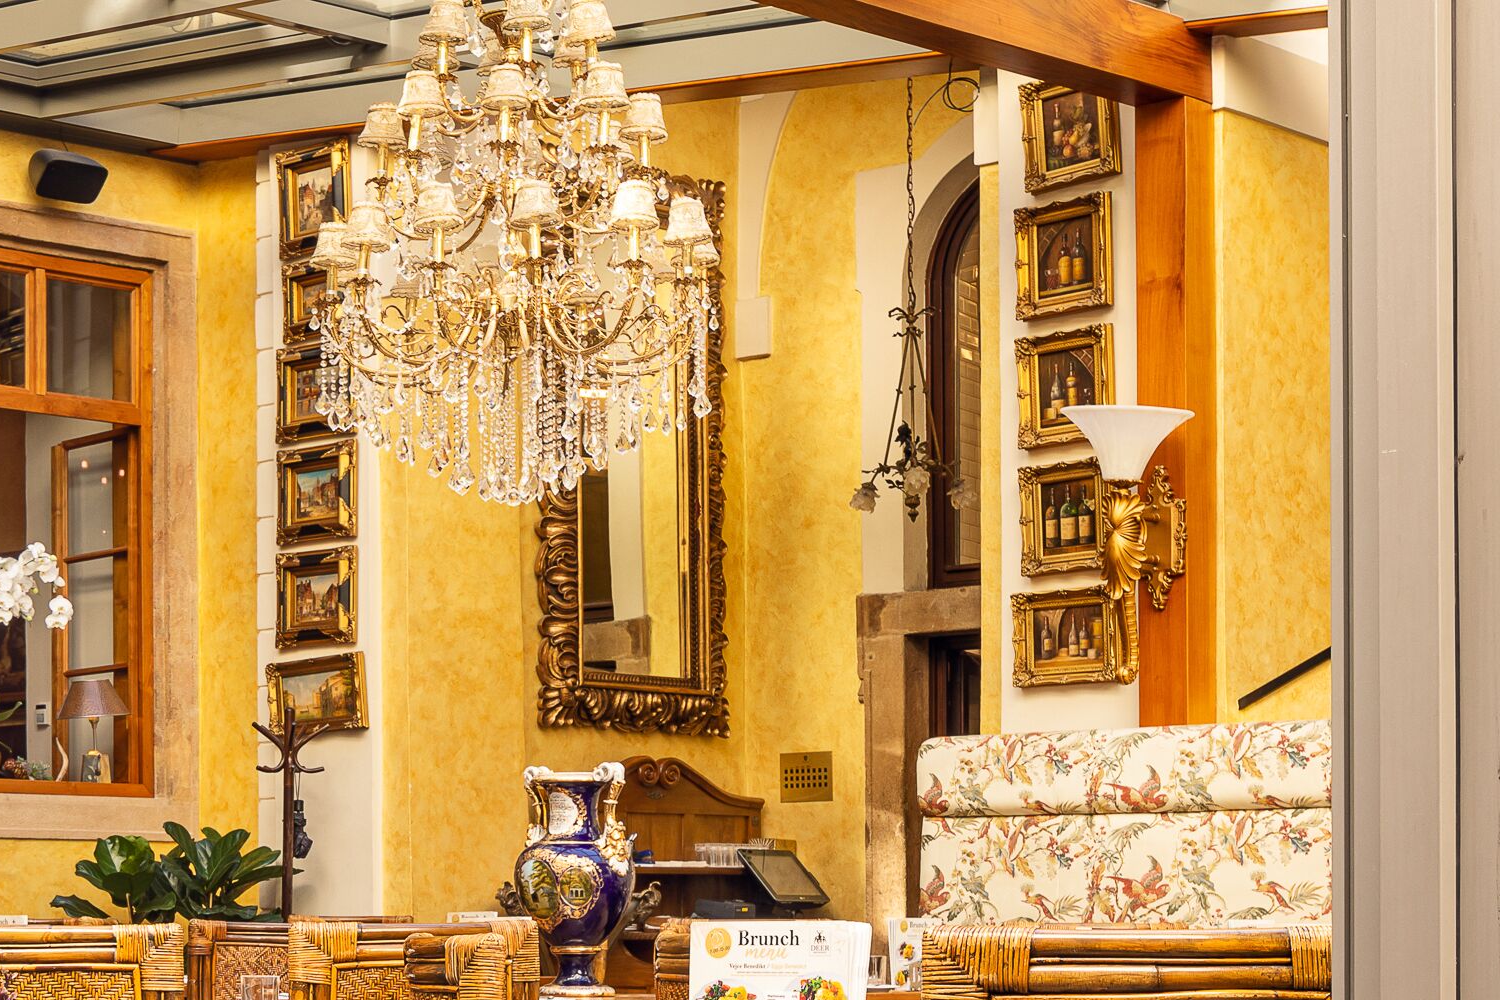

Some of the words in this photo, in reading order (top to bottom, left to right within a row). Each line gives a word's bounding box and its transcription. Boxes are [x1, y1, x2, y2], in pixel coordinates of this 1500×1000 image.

[738, 929, 800, 946] Brunch
[745, 946, 789, 961] menu
[810, 944, 830, 952] DEER
